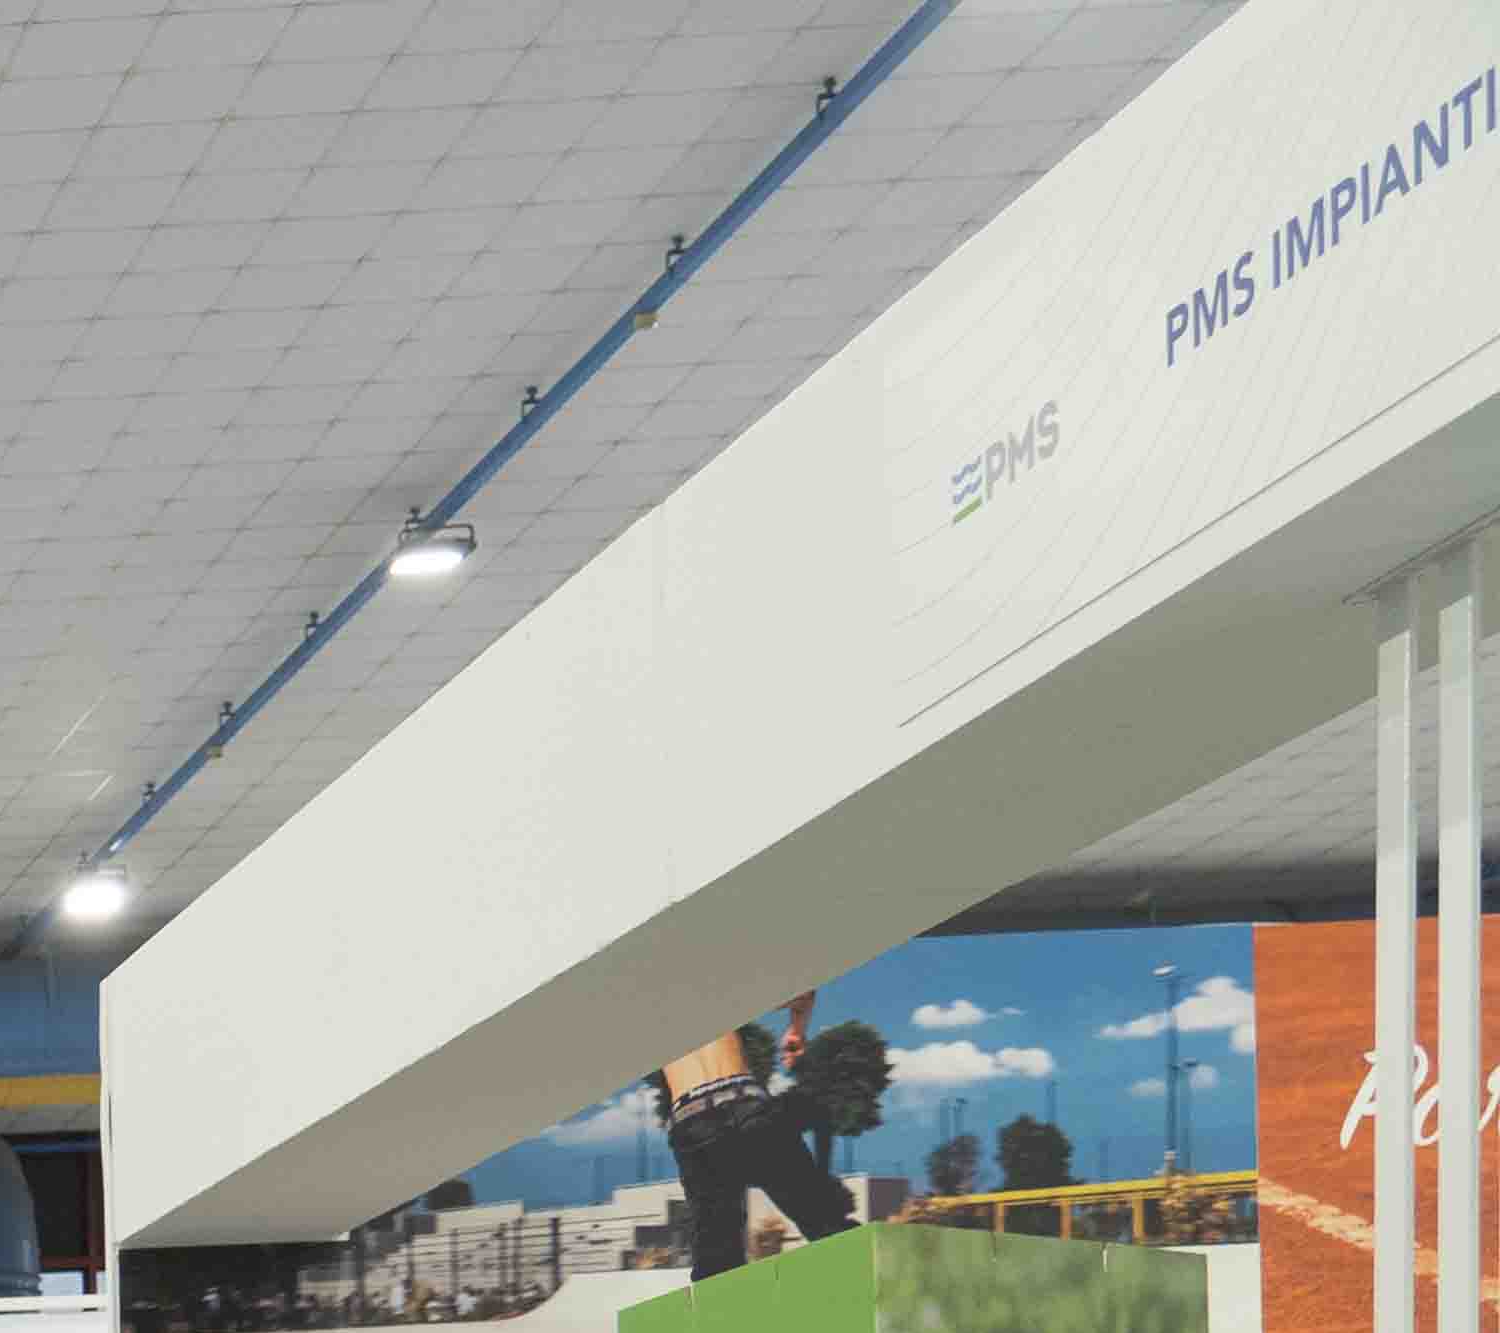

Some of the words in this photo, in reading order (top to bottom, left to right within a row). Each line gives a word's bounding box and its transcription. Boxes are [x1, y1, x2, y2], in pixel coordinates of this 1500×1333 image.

[1164, 250, 1257, 369] PMS
[1271, 64, 1498, 290] IMPIANTI
[982, 399, 1060, 502] PMS
